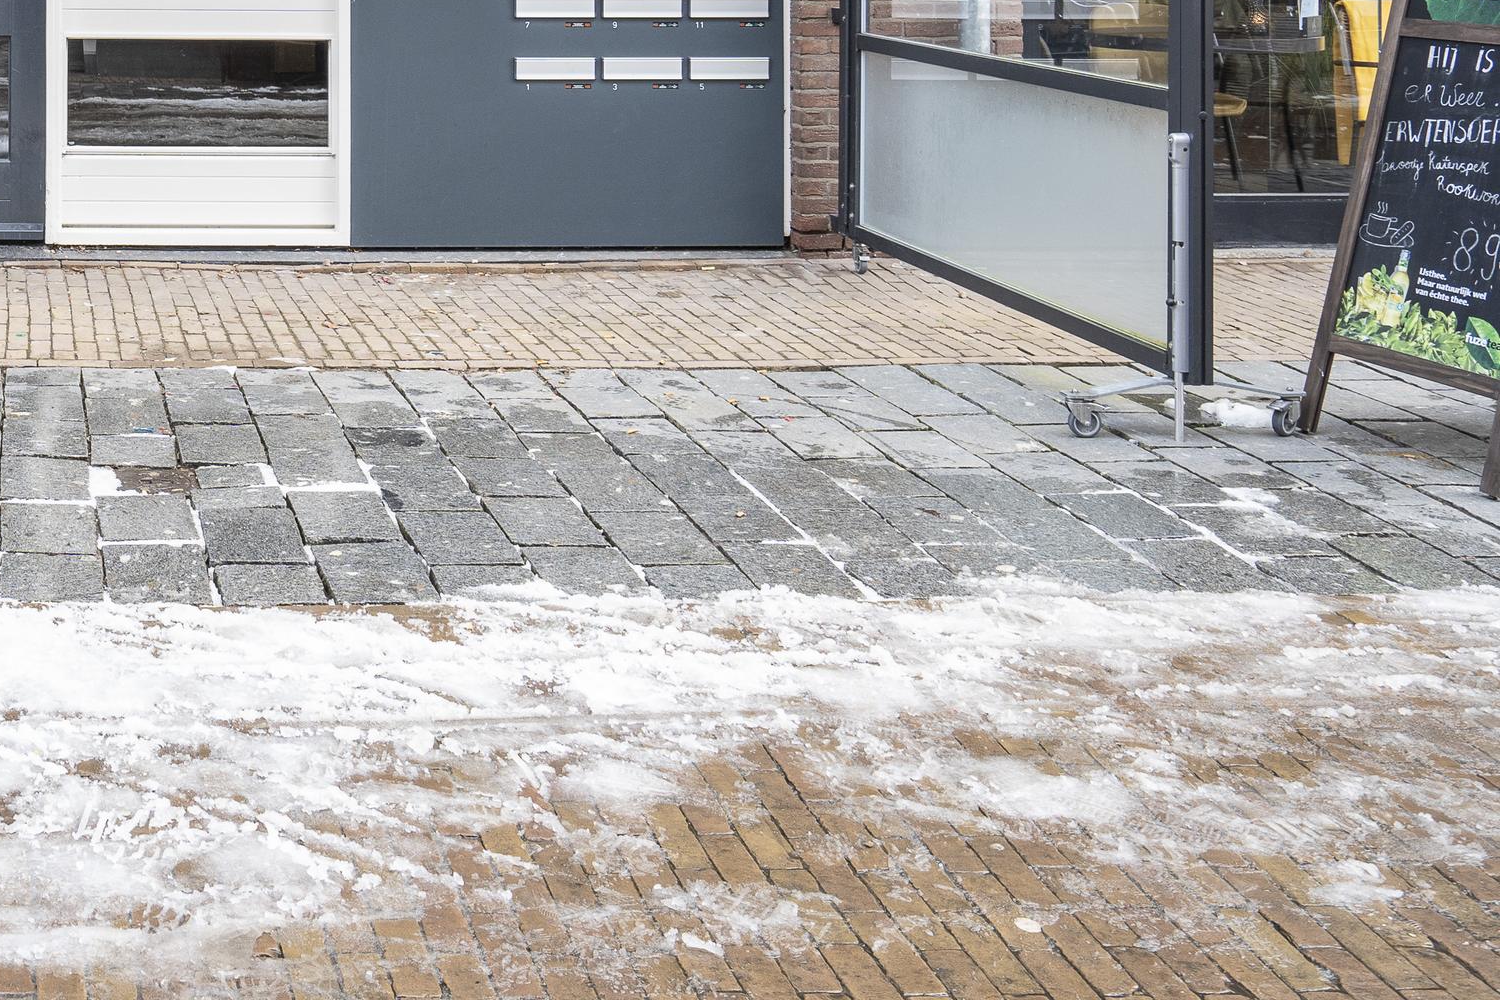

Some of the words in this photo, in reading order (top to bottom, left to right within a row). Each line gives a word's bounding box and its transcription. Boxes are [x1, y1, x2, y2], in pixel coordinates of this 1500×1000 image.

[695, 21, 704, 29] 11
[1415, 287, 1429, 297] van
[1429, 289, 1450, 302] échte
[1450, 292, 1470, 307] thee.
[1416, 277, 1437, 288] Maar
[1436, 280, 1472, 298] natuurlijk
[1472, 292, 1488, 301] wel
